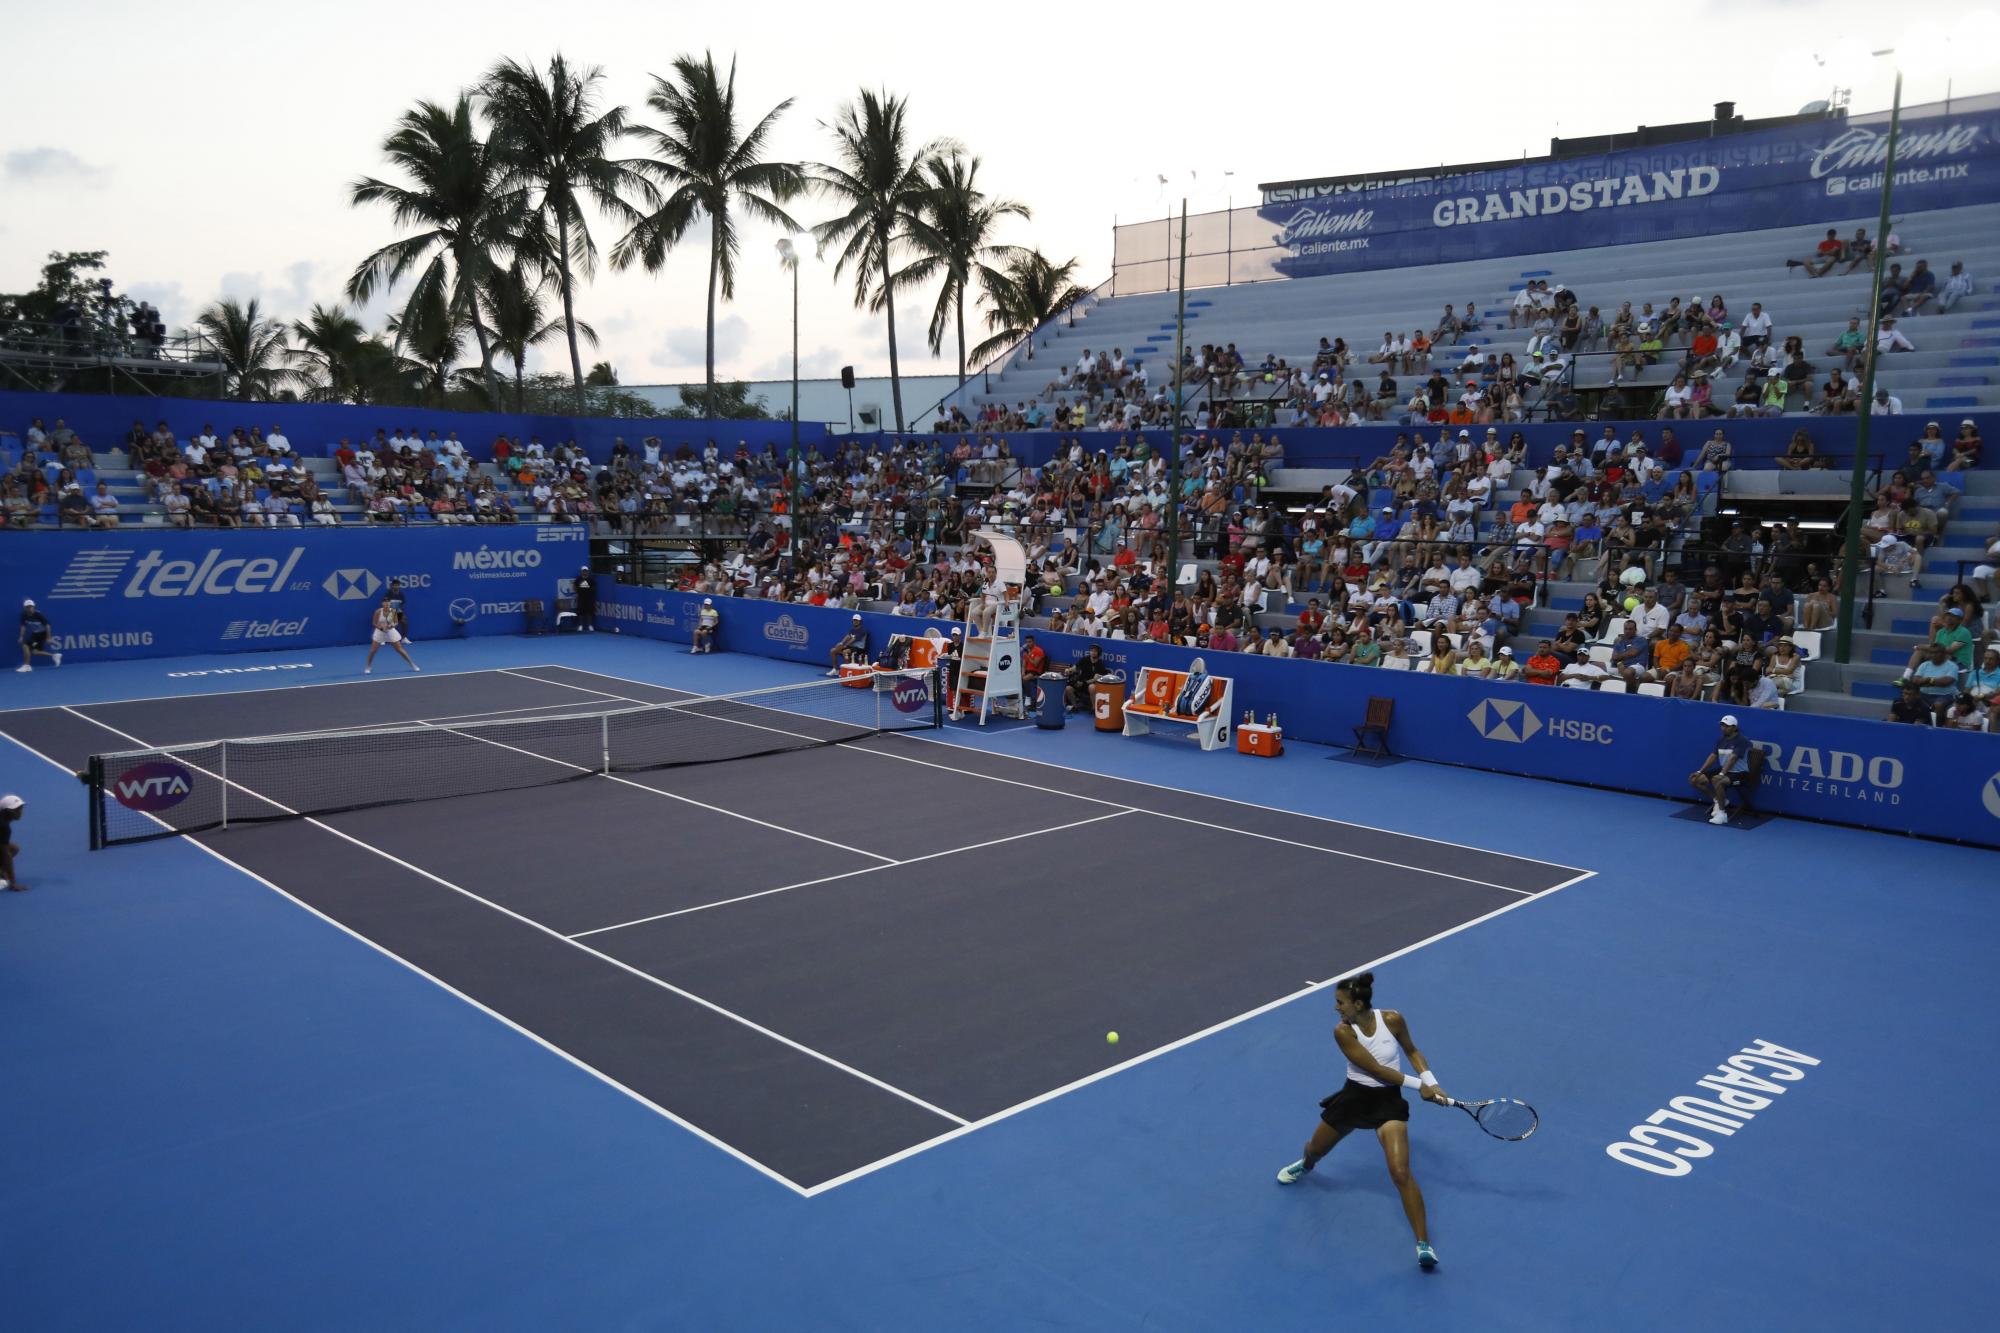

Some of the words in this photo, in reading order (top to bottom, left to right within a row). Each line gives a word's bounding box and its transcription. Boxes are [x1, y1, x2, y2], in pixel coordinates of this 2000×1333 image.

[1847, 163, 1968, 192] calinte.mx
[1432, 166, 1720, 228] GRANDSTAND
[1279, 207, 1374, 243] Caliente
[1301, 238, 1369, 256] caliente.mx
[536, 527, 585, 542] ESPN
[124, 547, 305, 598] telcel
[469, 571, 527, 580] visitmexico.com
[594, 601, 644, 622] SAMSUNG
[245, 617, 309, 639] telcel
[51, 631, 153, 651] SAMSUNG
[1116, 654, 1127, 664] DE
[894, 688, 927, 705] WTA
[1218, 726, 1227, 743] G
[1248, 733, 1259, 745] G
[1549, 718, 1614, 745] HSBC
[1750, 739, 1904, 788] RADO
[117, 775, 189, 799] WTA
[1760, 774, 1901, 805] WITZERLAND
[1606, 1038, 1822, 1177] ACAPULCO
